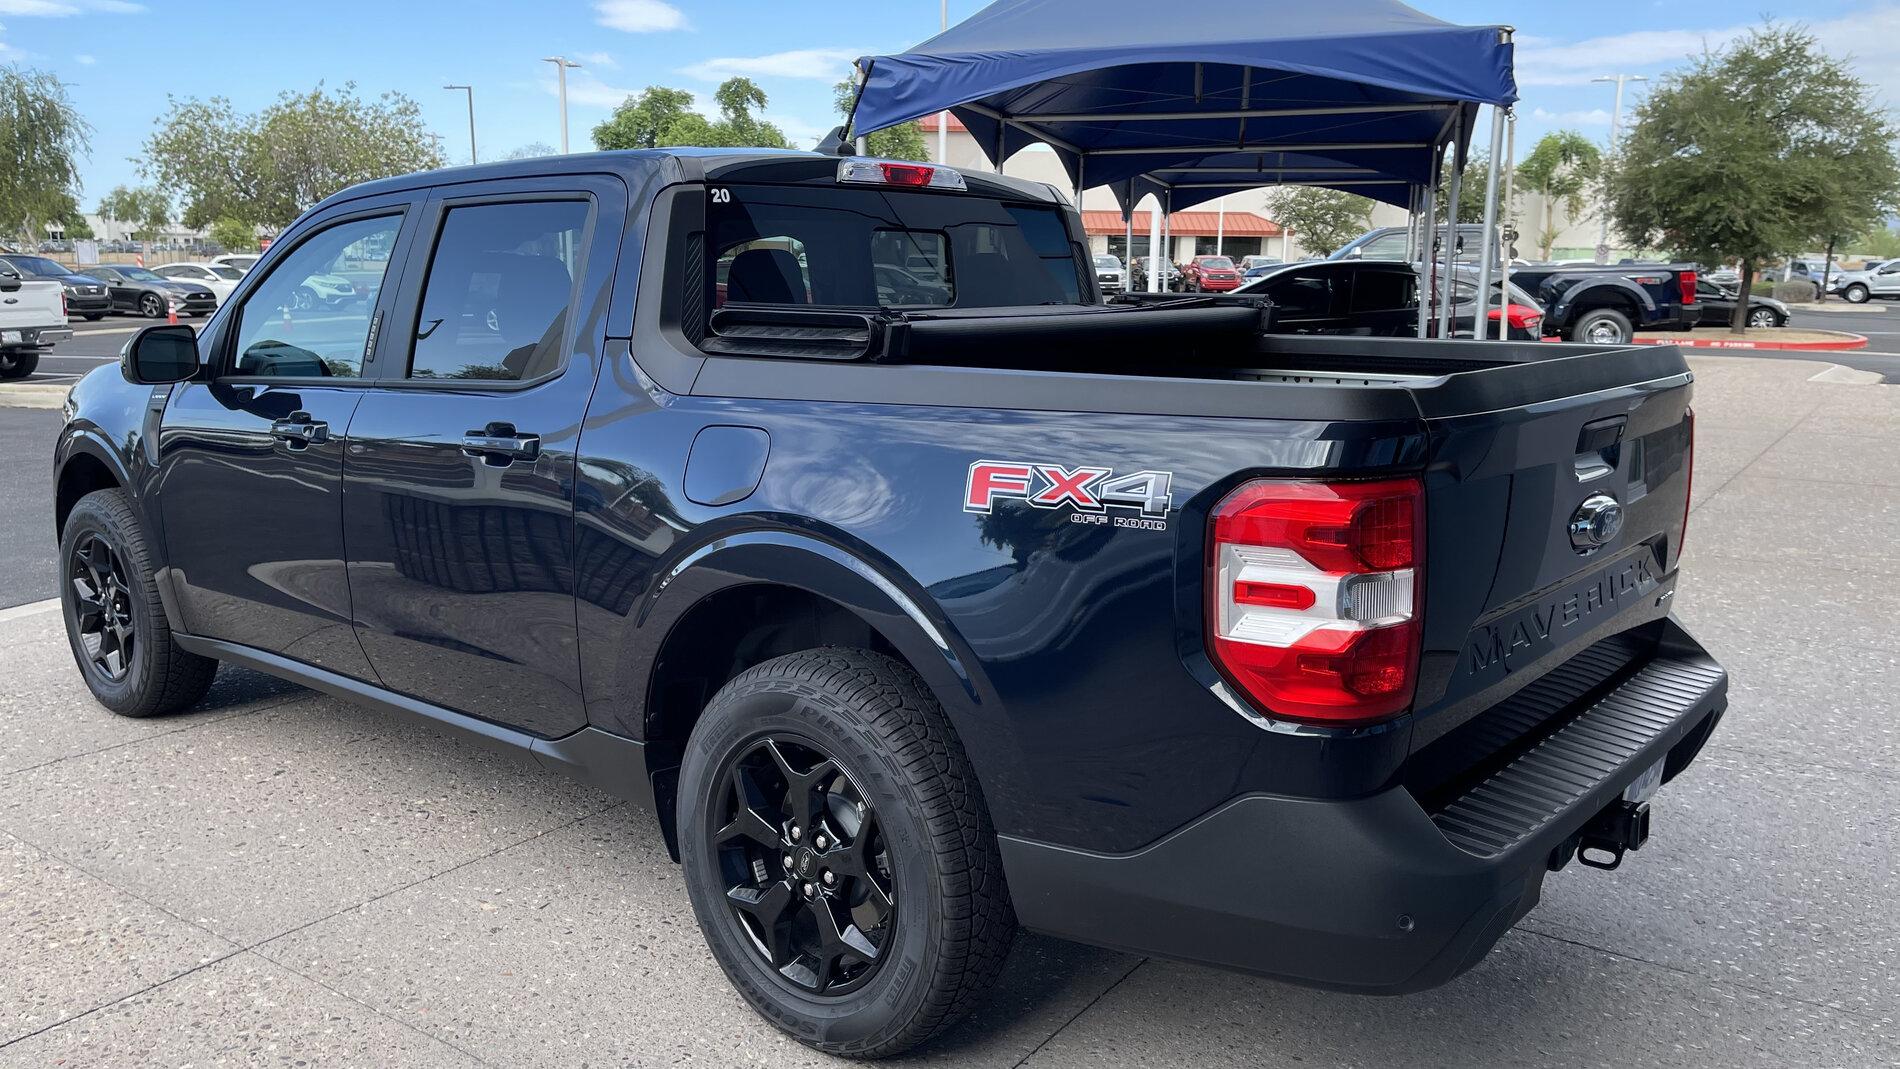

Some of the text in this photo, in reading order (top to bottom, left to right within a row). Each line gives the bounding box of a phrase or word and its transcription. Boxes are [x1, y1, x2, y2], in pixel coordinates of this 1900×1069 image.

[711, 188, 730, 203] 20
[963, 459, 1173, 519] FX4
[1070, 513, 1167, 531] OFF ROAD
[1467, 554, 1655, 676] MAVERICK
